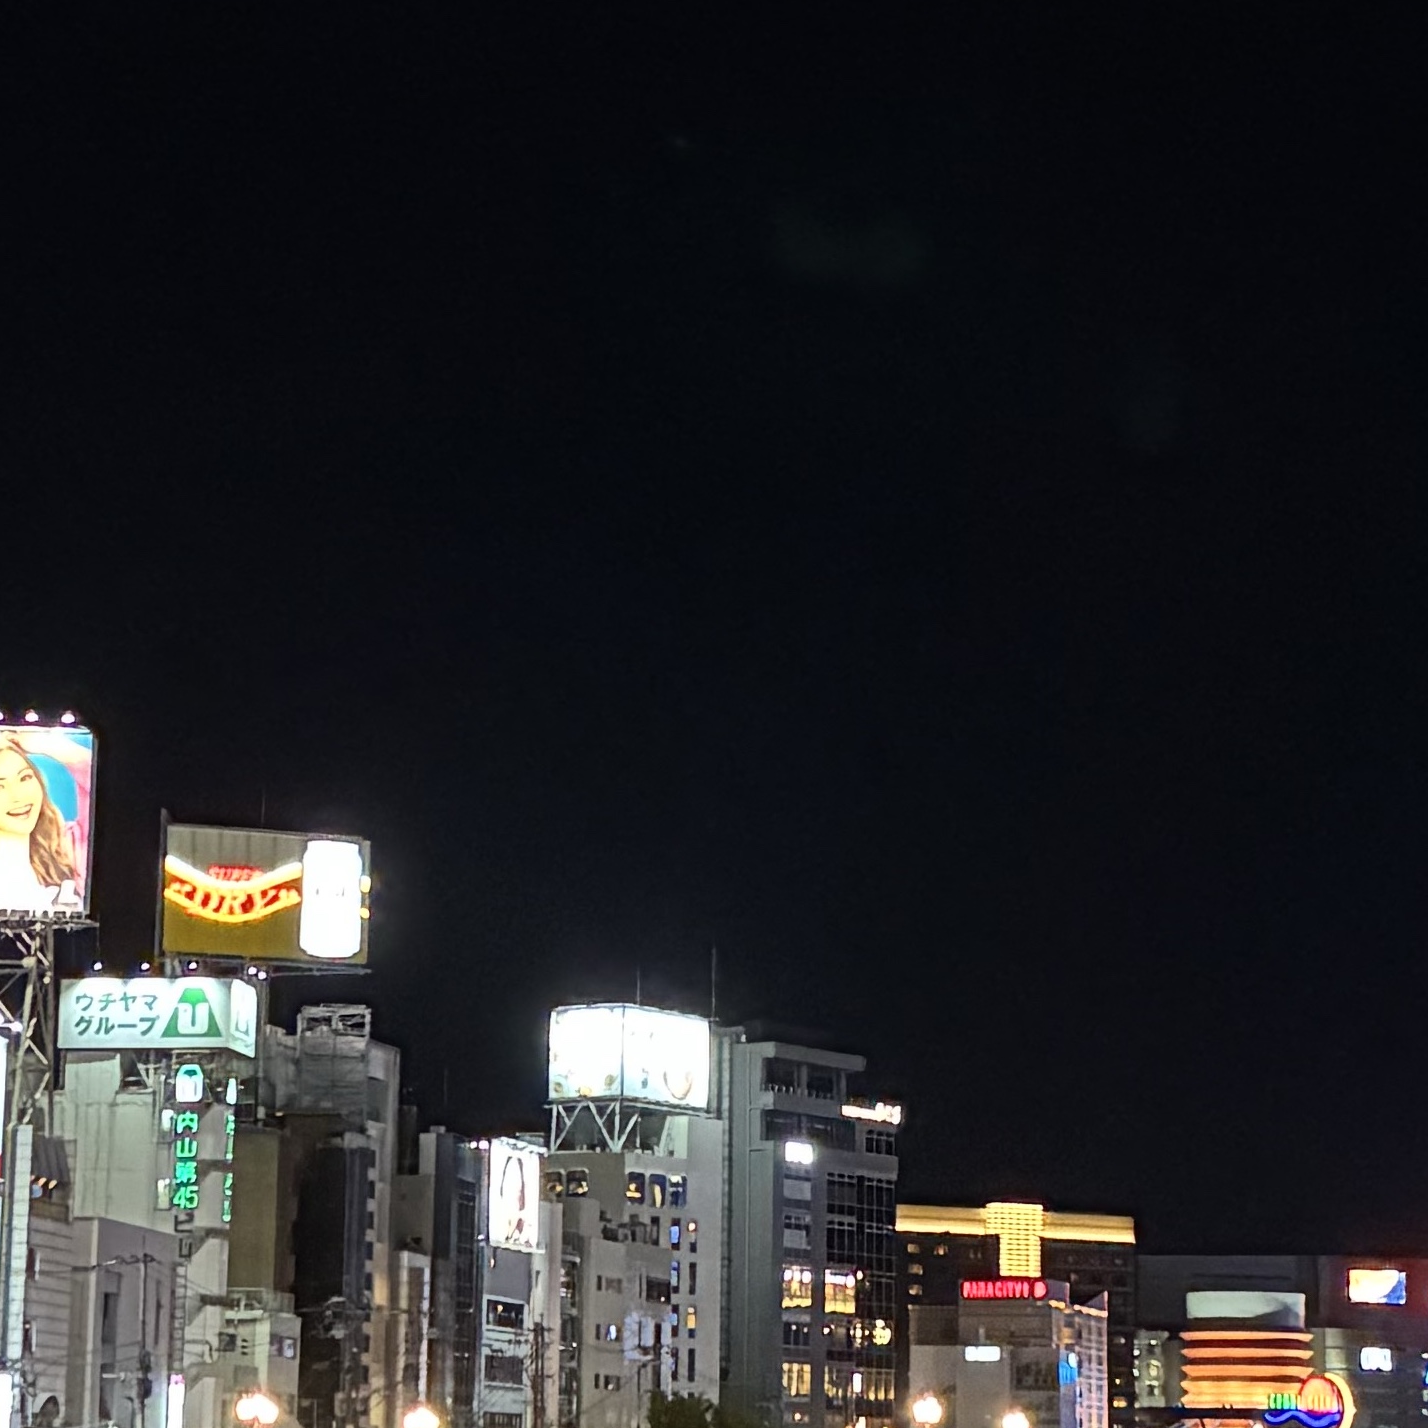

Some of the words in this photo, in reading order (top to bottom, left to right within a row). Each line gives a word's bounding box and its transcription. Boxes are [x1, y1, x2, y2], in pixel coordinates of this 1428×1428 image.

[75, 991, 158, 1012] ウチヤマ
[74, 1015, 160, 1036] グループ
